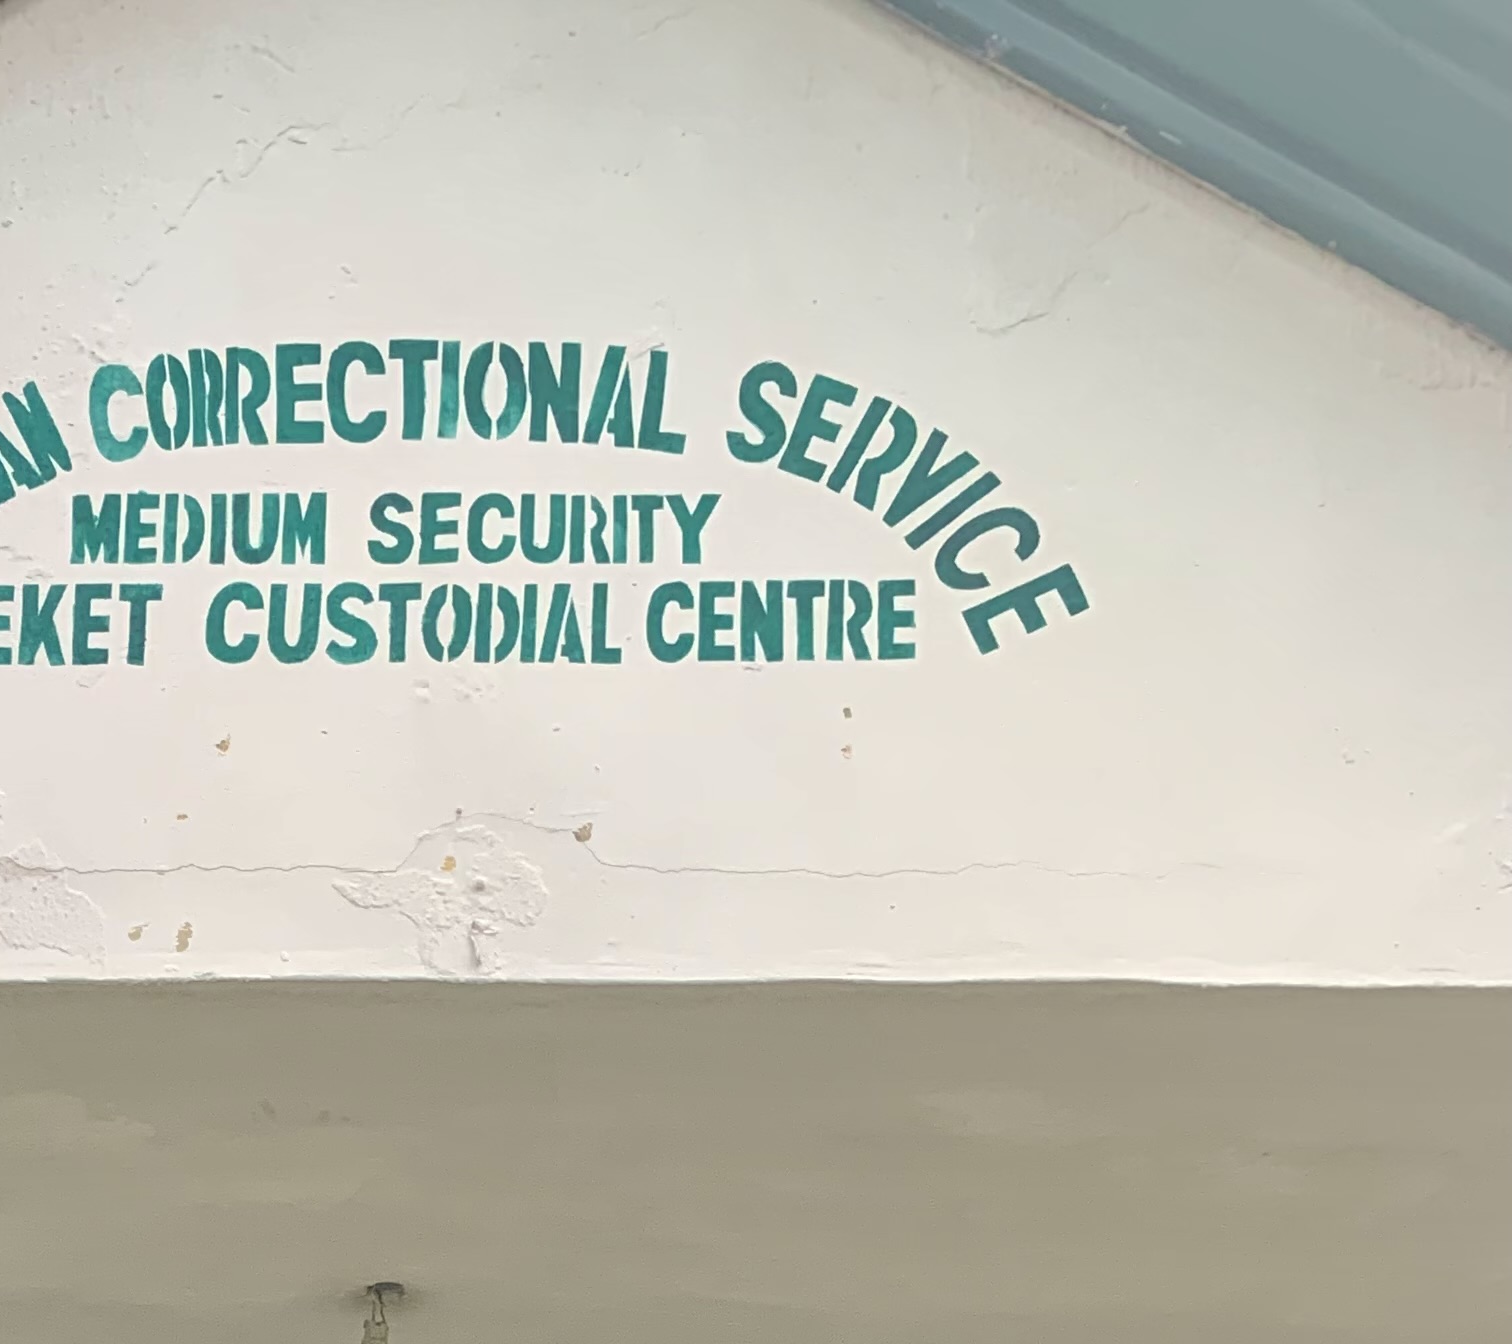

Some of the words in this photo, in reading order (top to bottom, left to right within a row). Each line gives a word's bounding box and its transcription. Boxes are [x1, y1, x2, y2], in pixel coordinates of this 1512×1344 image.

[71, 492, 327, 565] MEDIUM
[368, 492, 718, 564] SECURITY
[89, 339, 686, 462] CORRECTIONAL
[727, 362, 1088, 654] SERVICE
[205, 581, 622, 665] CUSTODIAL
[646, 580, 916, 661] CENTRE
